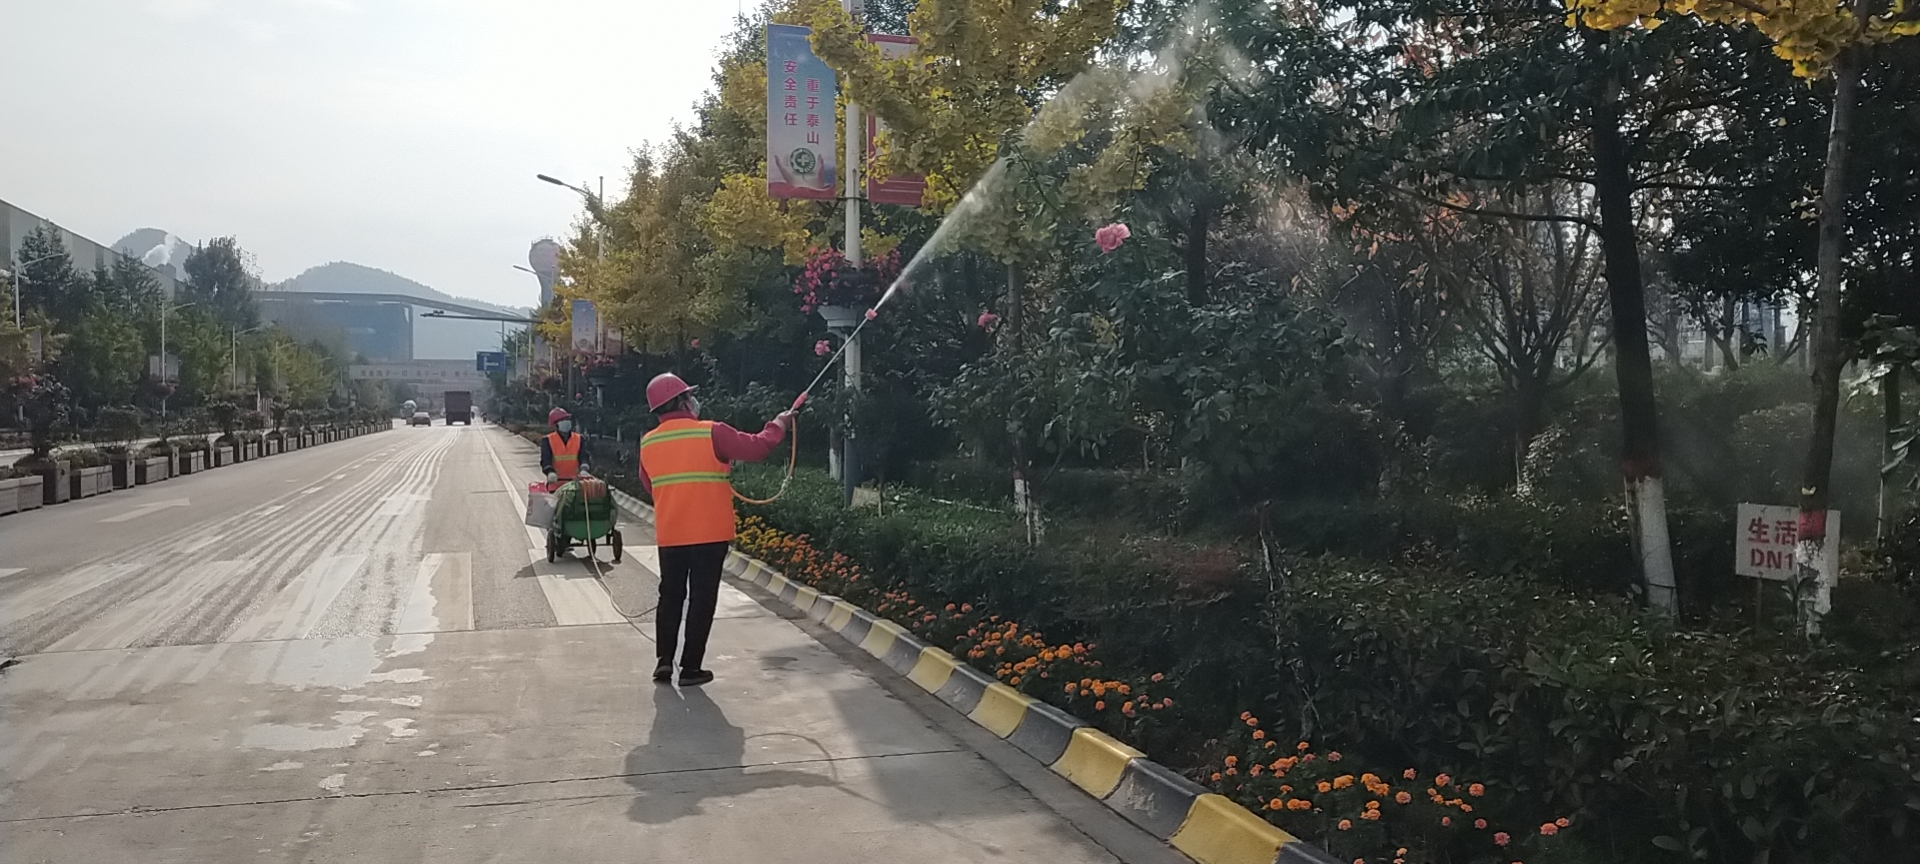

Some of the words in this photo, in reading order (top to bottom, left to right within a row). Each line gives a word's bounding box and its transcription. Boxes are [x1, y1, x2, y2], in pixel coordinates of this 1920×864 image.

[783, 60, 798, 126] 安全责任
[806, 78, 820, 145] 重于泰山
